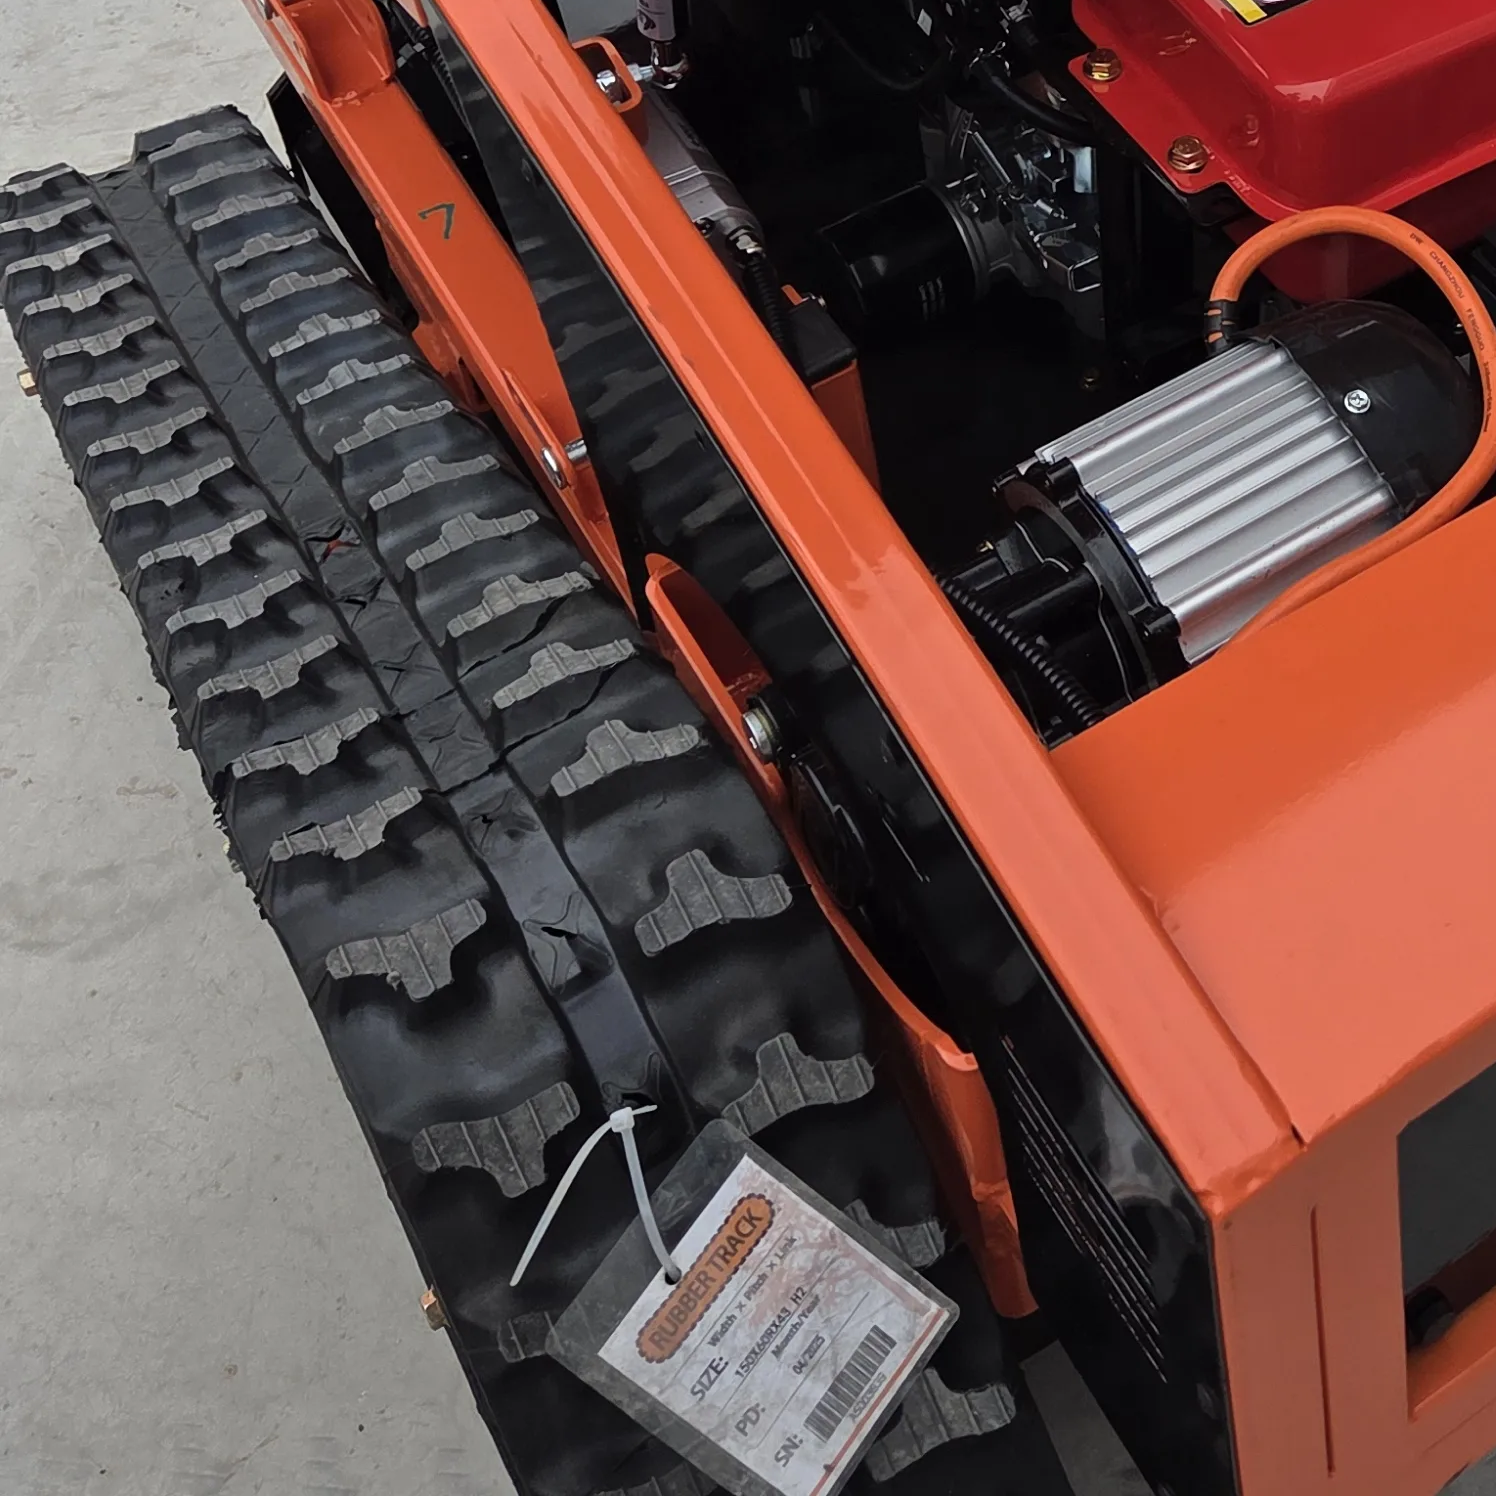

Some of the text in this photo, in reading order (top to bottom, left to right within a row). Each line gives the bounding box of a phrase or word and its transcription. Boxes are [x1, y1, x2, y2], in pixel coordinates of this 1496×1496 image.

[417, 202, 456, 240] 7
[648, 1207, 764, 1351] RUBBER TRACK
[707, 1313, 738, 1347] Width
[743, 1272, 768, 1301] Pitch
[775, 1236, 798, 1261] Link
[789, 1286, 808, 1307] H2
[771, 1294, 821, 1360] Month/Year
[690, 1356, 729, 1402] SIZE:
[734, 1403, 766, 1437] PD:
[774, 1434, 804, 1468] SN:
